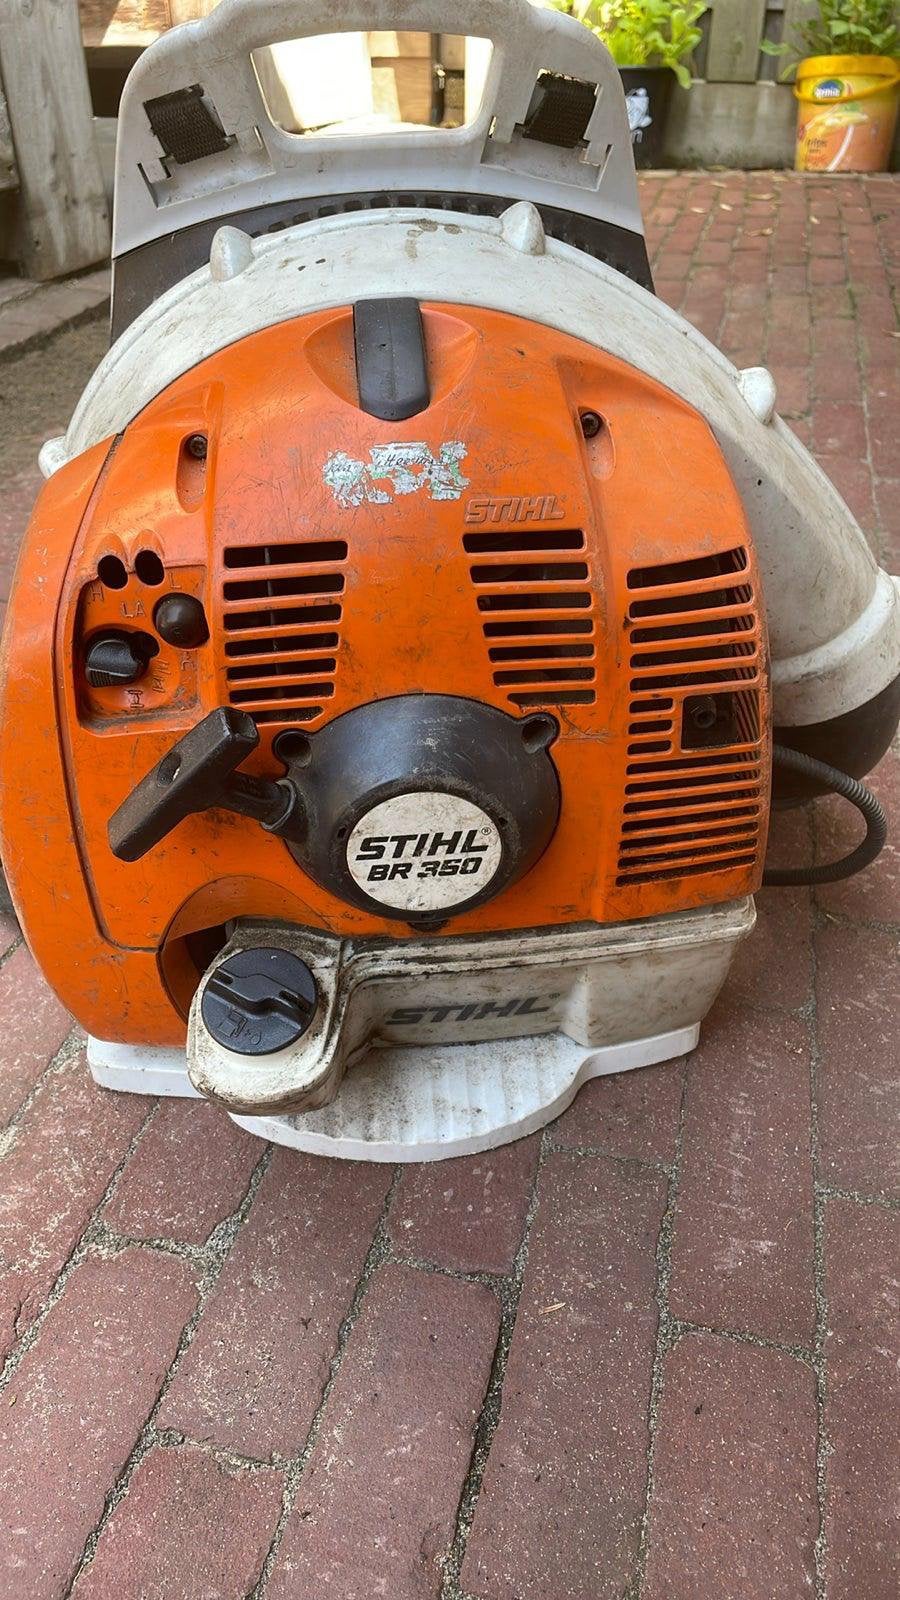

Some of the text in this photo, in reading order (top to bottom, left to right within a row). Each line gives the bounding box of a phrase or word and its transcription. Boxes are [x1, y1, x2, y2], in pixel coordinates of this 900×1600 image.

[464, 496, 565, 523] STIHL
[355, 829, 489, 861] STIHL
[366, 856, 483, 882] BR 350
[385, 997, 550, 1025] STIHL
